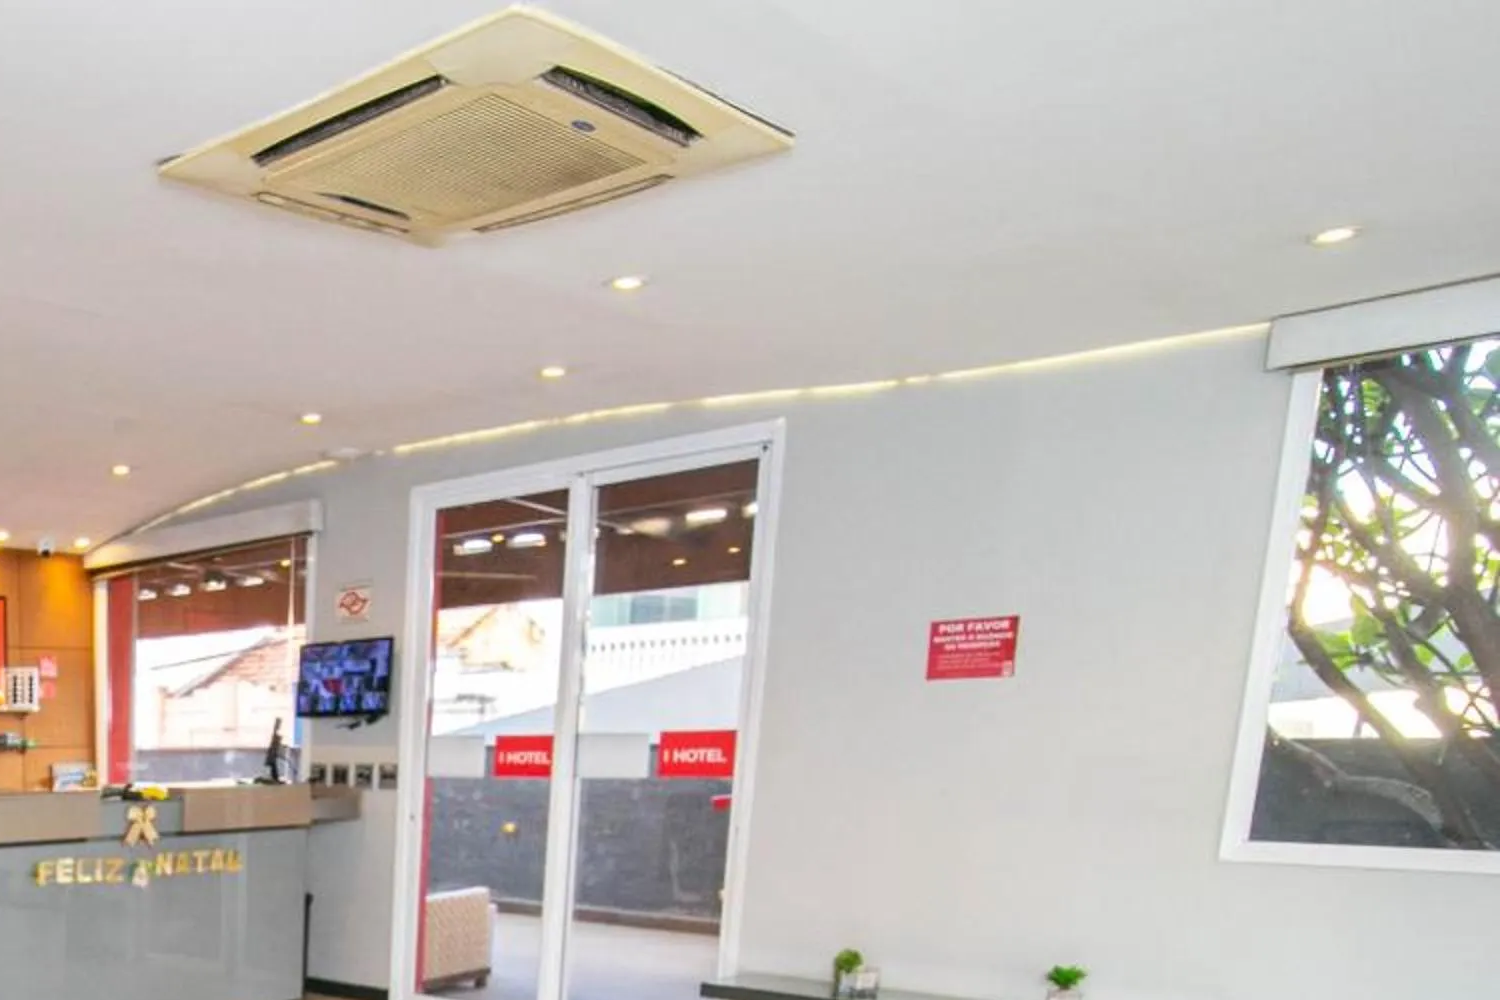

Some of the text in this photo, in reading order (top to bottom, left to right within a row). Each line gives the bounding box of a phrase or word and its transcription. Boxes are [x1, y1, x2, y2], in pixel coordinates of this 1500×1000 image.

[938, 620, 1010, 634] POR FAVOR
[507, 752, 551, 765] HOTEL
[673, 748, 727, 763] HOTEL
[34, 849, 243, 887] FELIZ NATAL
